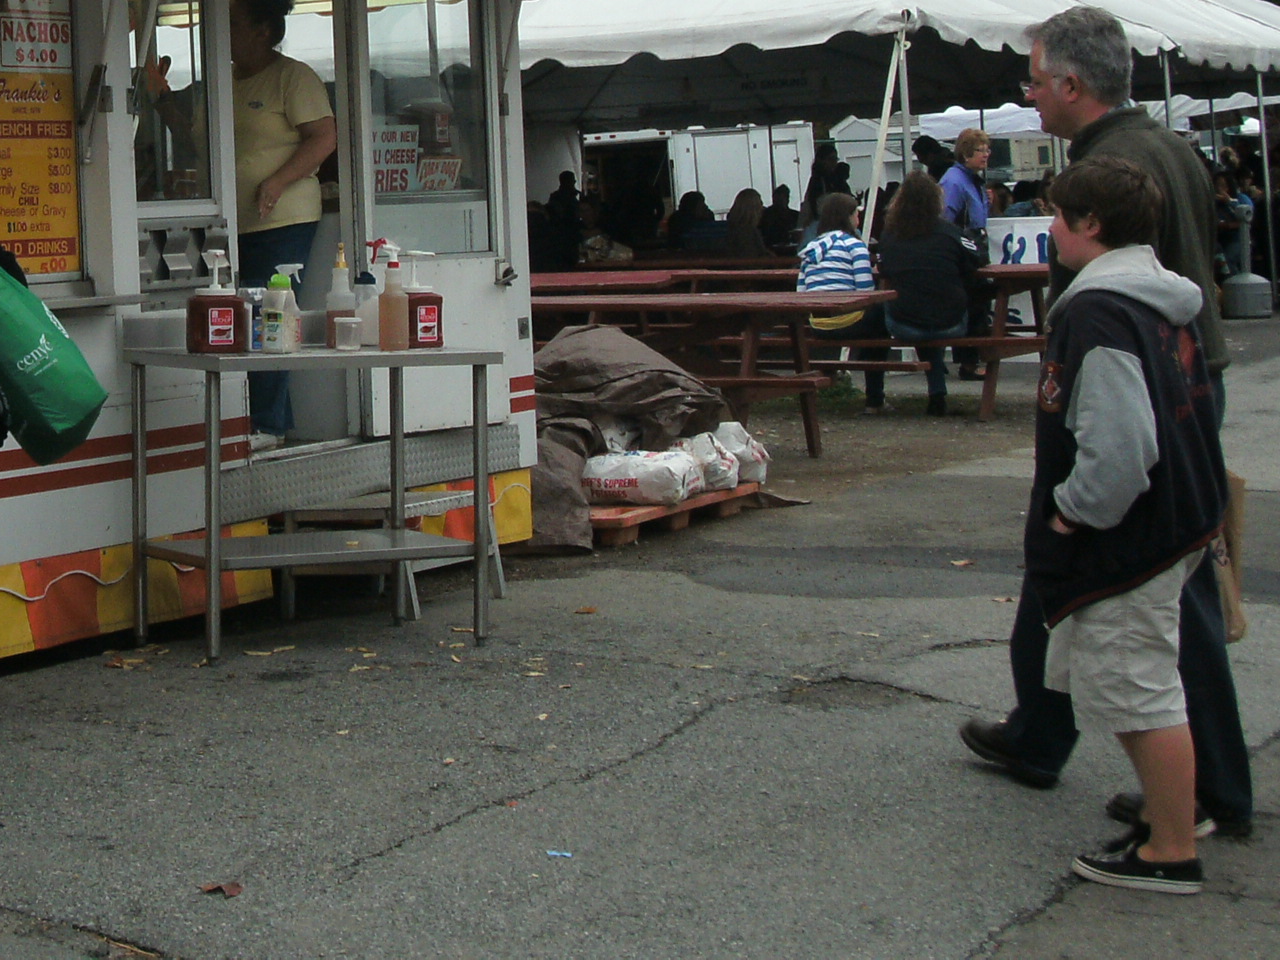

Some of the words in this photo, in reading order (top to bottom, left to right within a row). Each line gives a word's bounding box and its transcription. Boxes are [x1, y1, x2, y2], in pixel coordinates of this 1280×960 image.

[1, 21, 70, 44] NACHOS
[15, 47, 58, 63] $4.00
[37, 123, 68, 136] FRIES
[381, 131, 397, 143] OUR
[400, 130, 417, 143] NEW
[47, 147, 71, 159] $3.00
[385, 148, 416, 164] CHEESE
[375, 168, 408, 192] RIES
[21, 182, 40, 194] Size
[18, 197, 39, 206] CHILI
[29, 208, 39, 217] or
[42, 204, 67, 218] Gravy
[30, 222, 51, 232] extra
[28, 240, 69, 254] DRINKS
[603, 477, 639, 489] SUPREME
